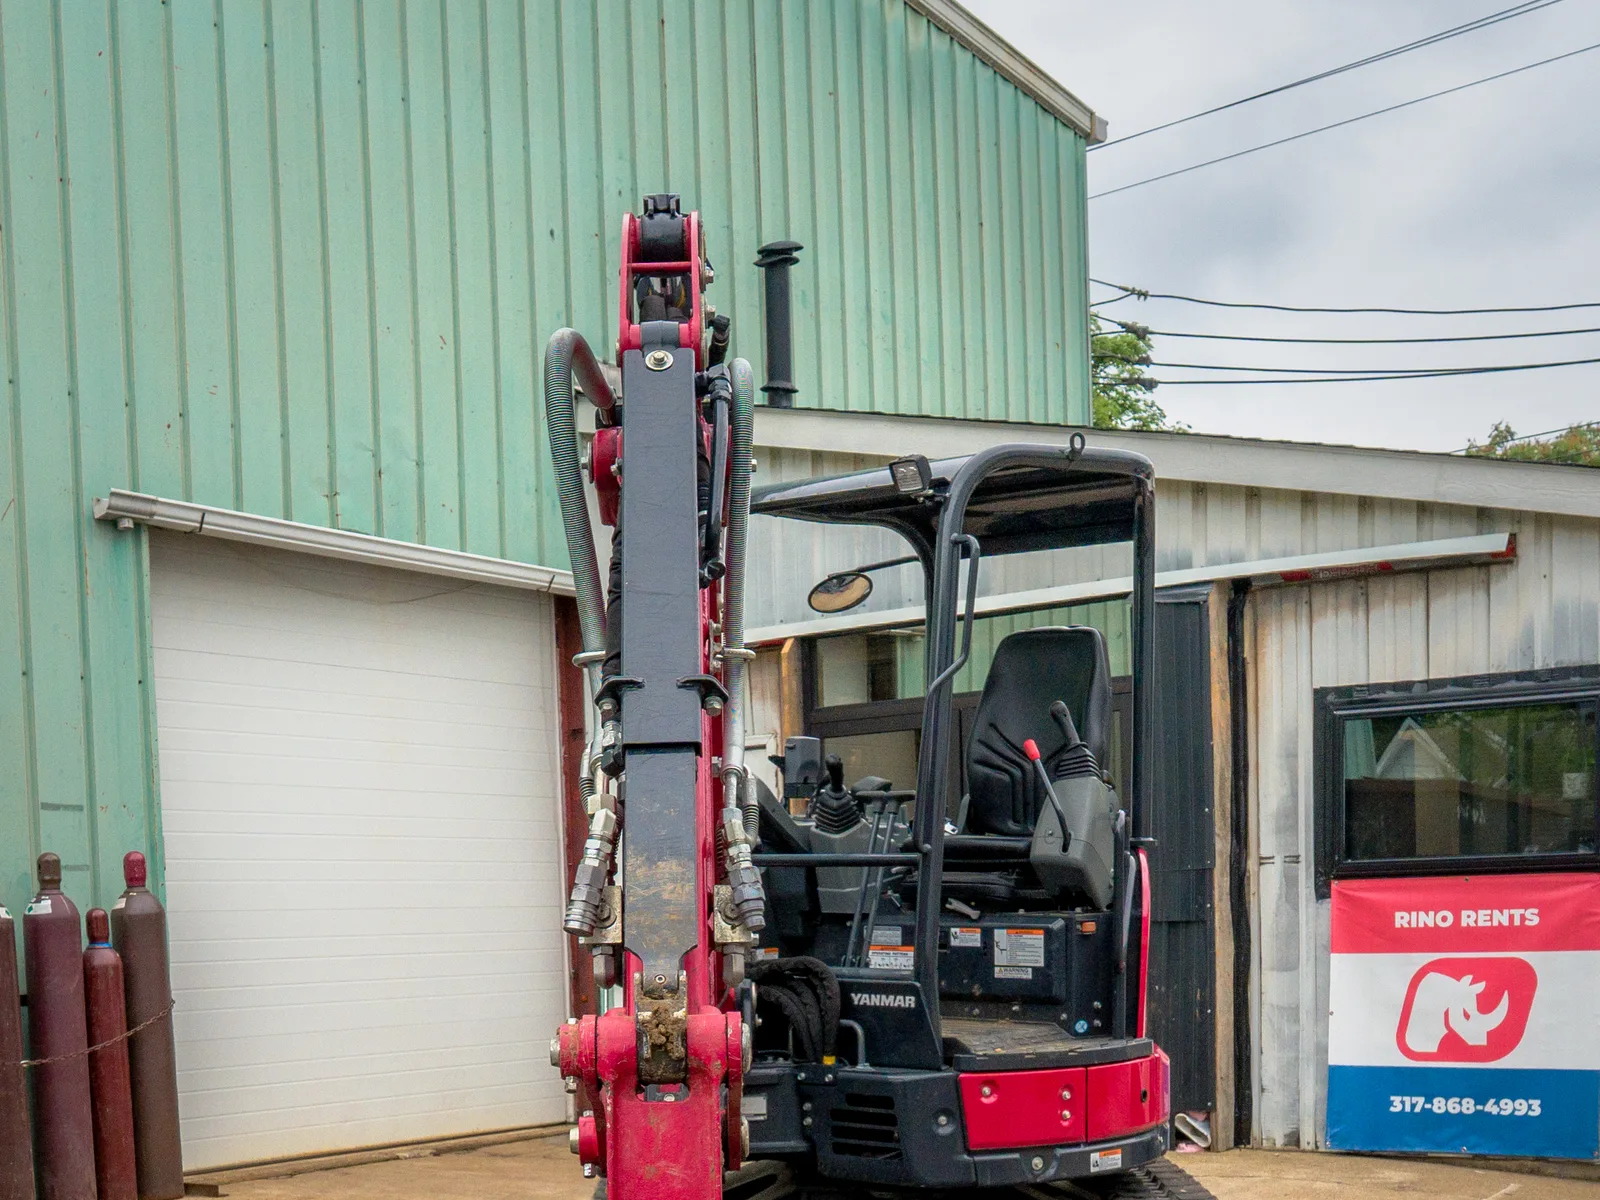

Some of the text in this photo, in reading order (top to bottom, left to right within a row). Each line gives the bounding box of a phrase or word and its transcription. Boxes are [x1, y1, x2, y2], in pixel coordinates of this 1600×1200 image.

[1394, 908, 1540, 928] RINO RENTS
[850, 993, 916, 1008] YANMAR
[1389, 1096, 1541, 1116] 317-868-4993
